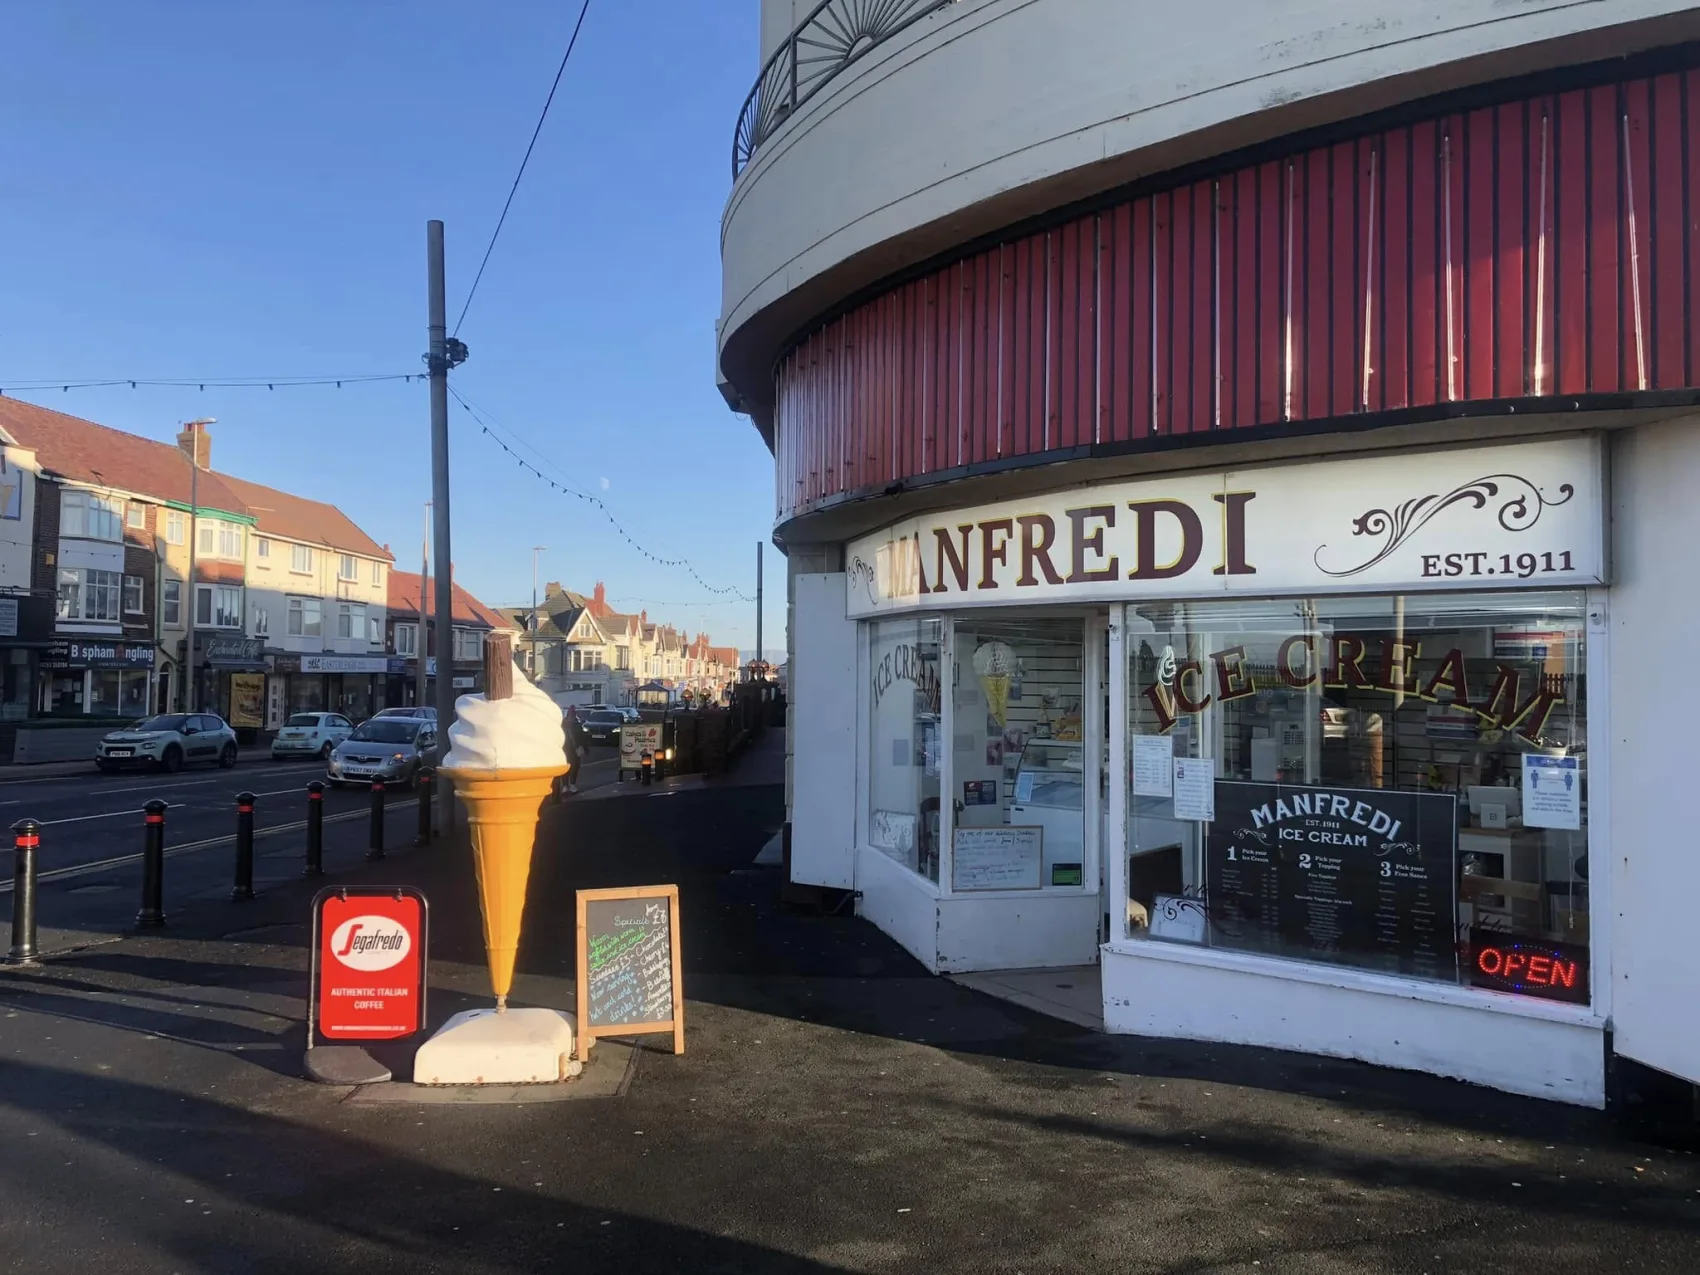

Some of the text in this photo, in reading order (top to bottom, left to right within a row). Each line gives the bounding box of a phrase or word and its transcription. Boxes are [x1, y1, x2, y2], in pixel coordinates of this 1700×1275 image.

[887, 491, 1257, 598] MANFREDI
[1421, 550, 1576, 578] EST.1911
[71, 644, 154, 661] Bspham Angling
[873, 652, 892, 708] ICE
[1143, 632, 1565, 749] ICE CREAM
[1250, 793, 1402, 841] MANFREDI
[1305, 819, 1340, 828] EST.1911
[1279, 828, 1368, 847] ICE CREAM
[1227, 846, 1237, 861] 1
[1299, 853, 1311, 868] 2
[1380, 861, 1391, 877] 3
[337, 923, 404, 956] Segafredo
[1478, 947, 1576, 988] OPEN
[331, 988, 408, 997] AUTHENTIC ITALIAN
[354, 1000, 384, 1009] COFFEE
